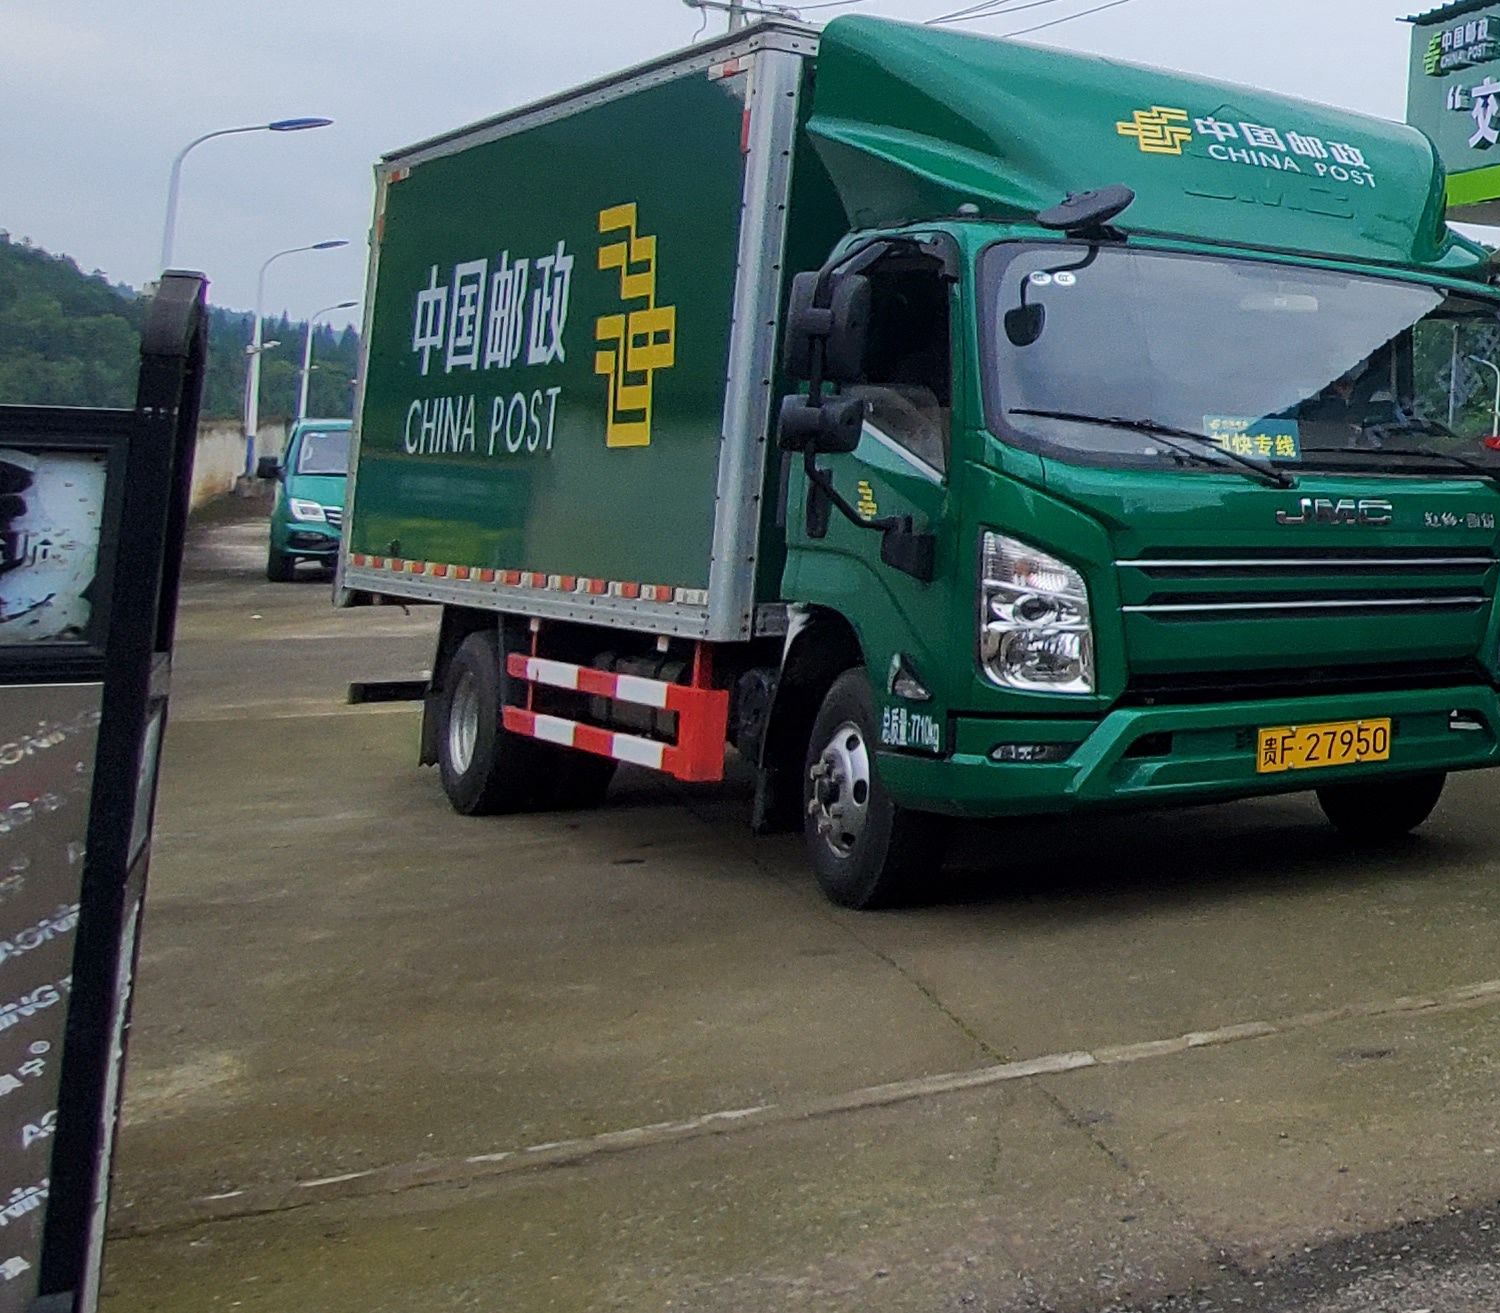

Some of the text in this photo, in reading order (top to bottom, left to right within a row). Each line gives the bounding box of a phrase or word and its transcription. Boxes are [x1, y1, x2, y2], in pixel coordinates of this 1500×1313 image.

[1441, 17, 1488, 53] 中国邮政
[1194, 117, 1370, 170] 中国邮政
[1208, 144, 1376, 188] CHINA POST
[412, 239, 575, 376] 中国邮政
[405, 387, 562, 456] CHINA POST
[1276, 498, 1393, 526] JMC
